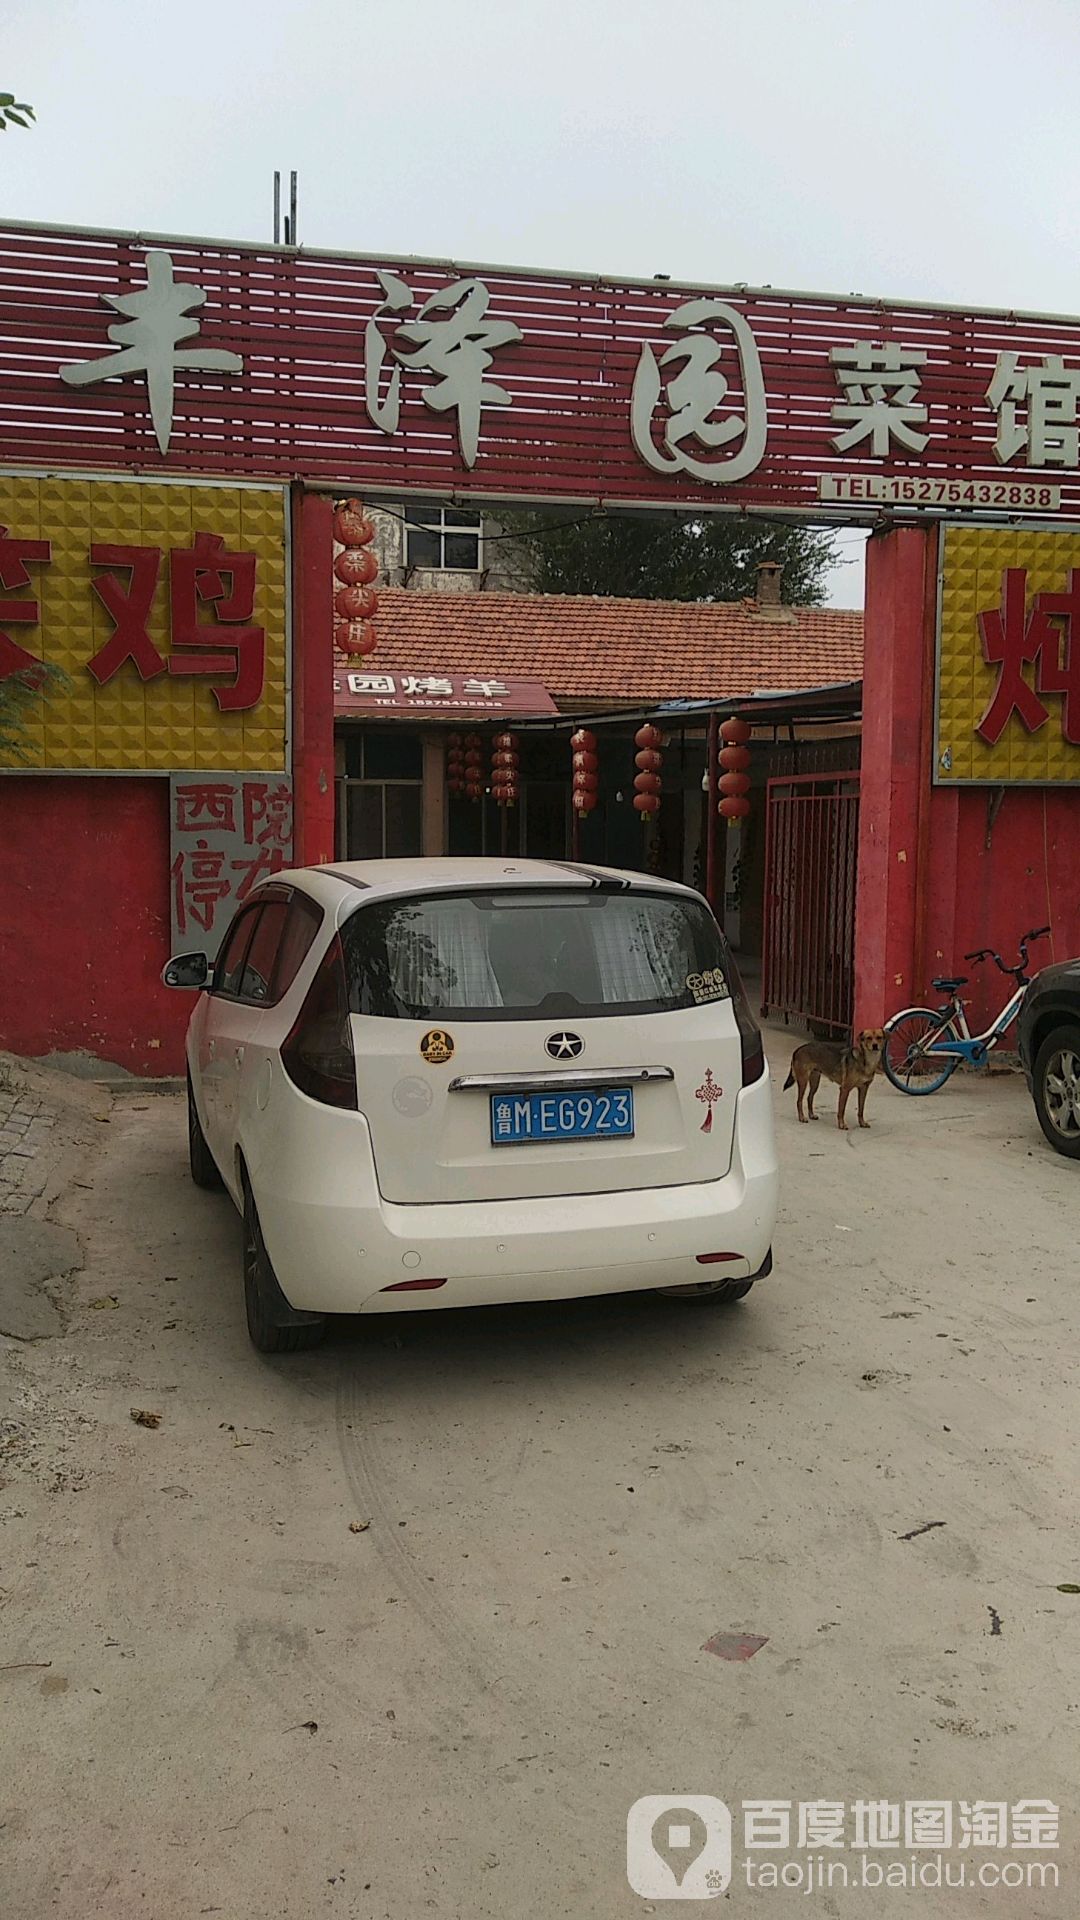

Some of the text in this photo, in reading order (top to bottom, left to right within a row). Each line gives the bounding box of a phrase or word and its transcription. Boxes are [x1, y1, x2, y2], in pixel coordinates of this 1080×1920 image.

[832, 478, 1051, 506] TEL:15275432838
[334, 674, 510, 697] 园烤羊
[174, 782, 293, 845] 西院
